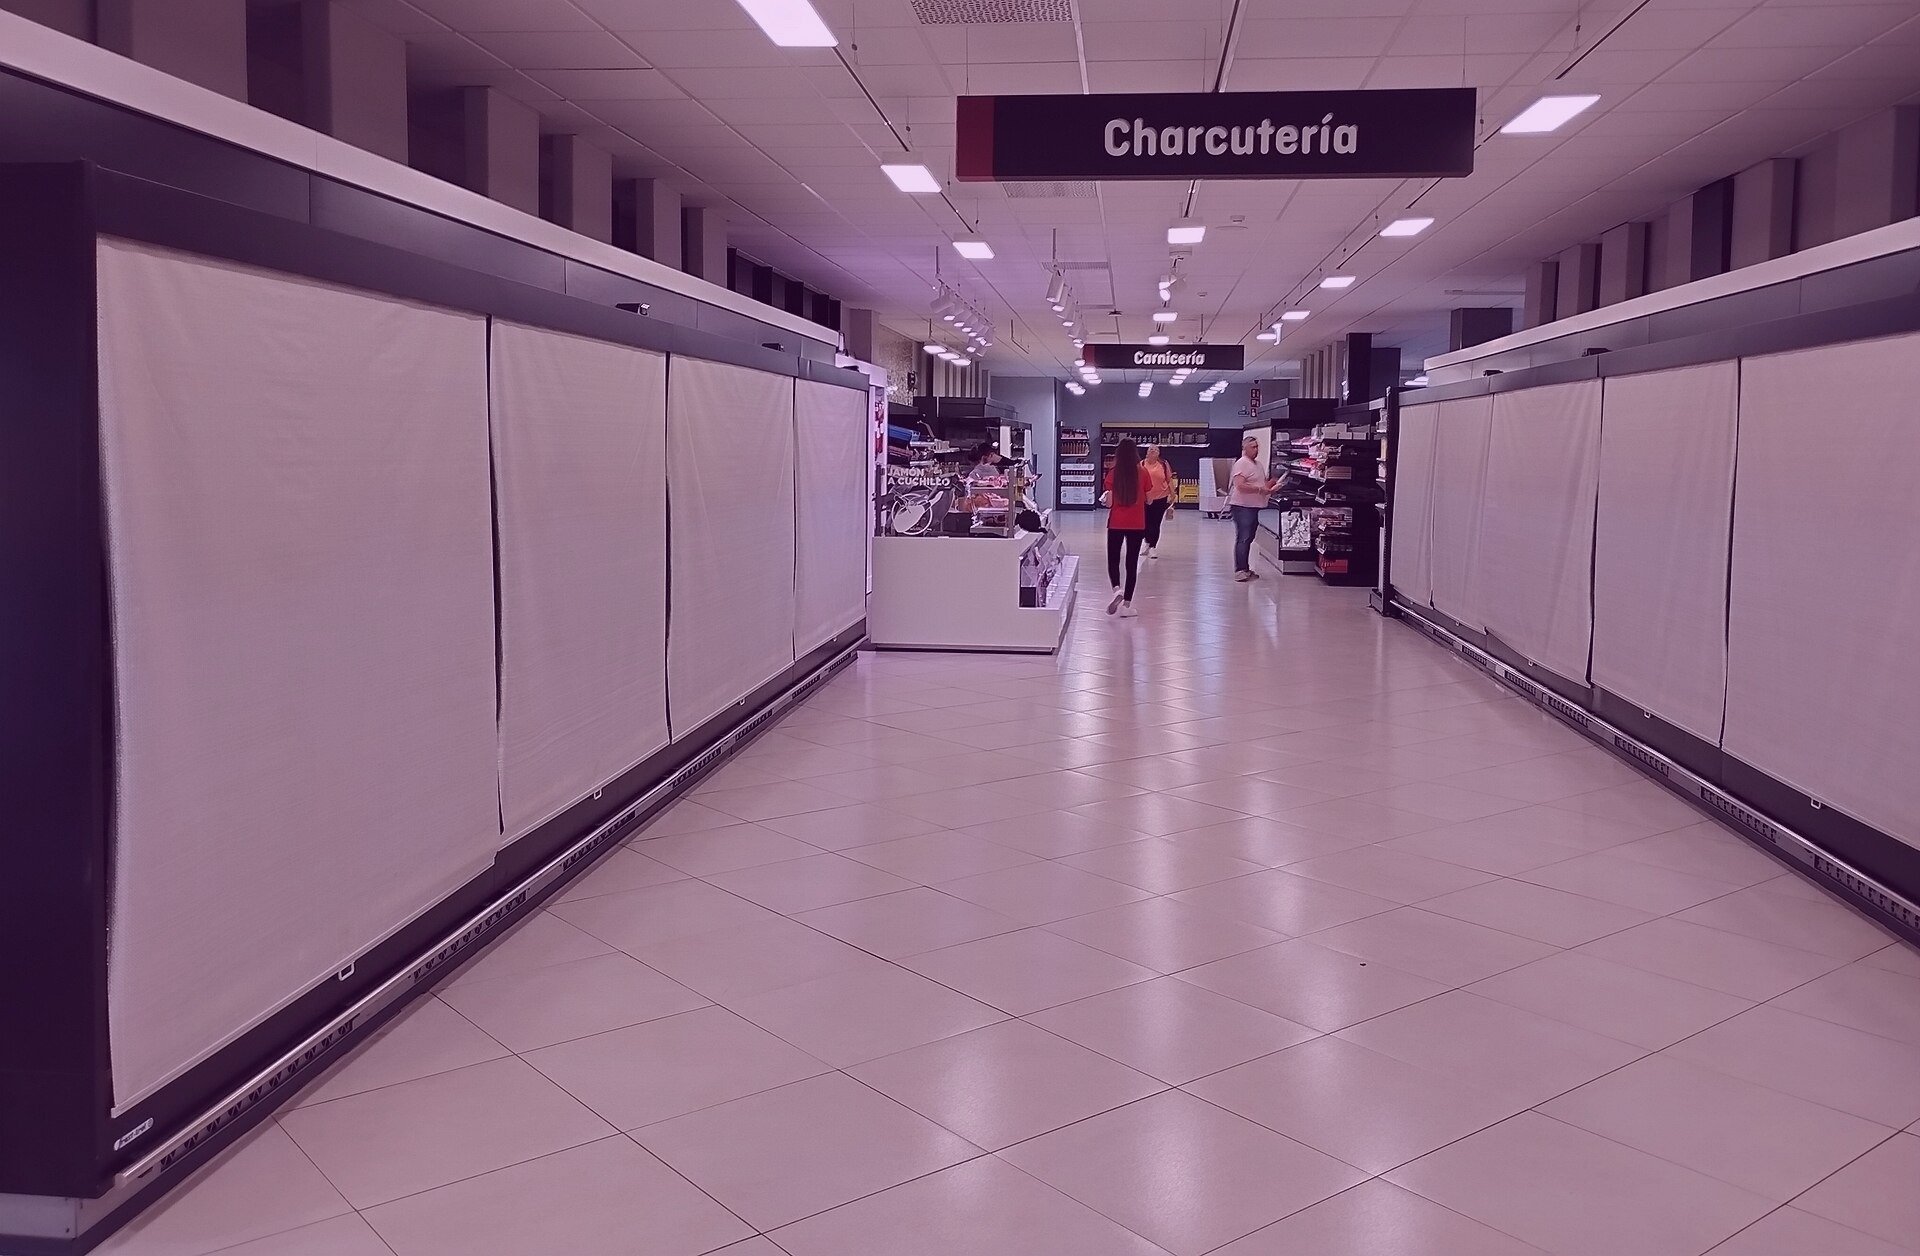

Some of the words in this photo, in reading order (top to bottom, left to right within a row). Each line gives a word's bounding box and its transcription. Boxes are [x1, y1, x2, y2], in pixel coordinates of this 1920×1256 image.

[1104, 112, 1359, 157] Charcutería
[1133, 350, 1206, 365] Carnicería
[887, 466, 925, 477] JAMÓN
[887, 477, 896, 485] A
[897, 477, 951, 487] CUCHILLO
